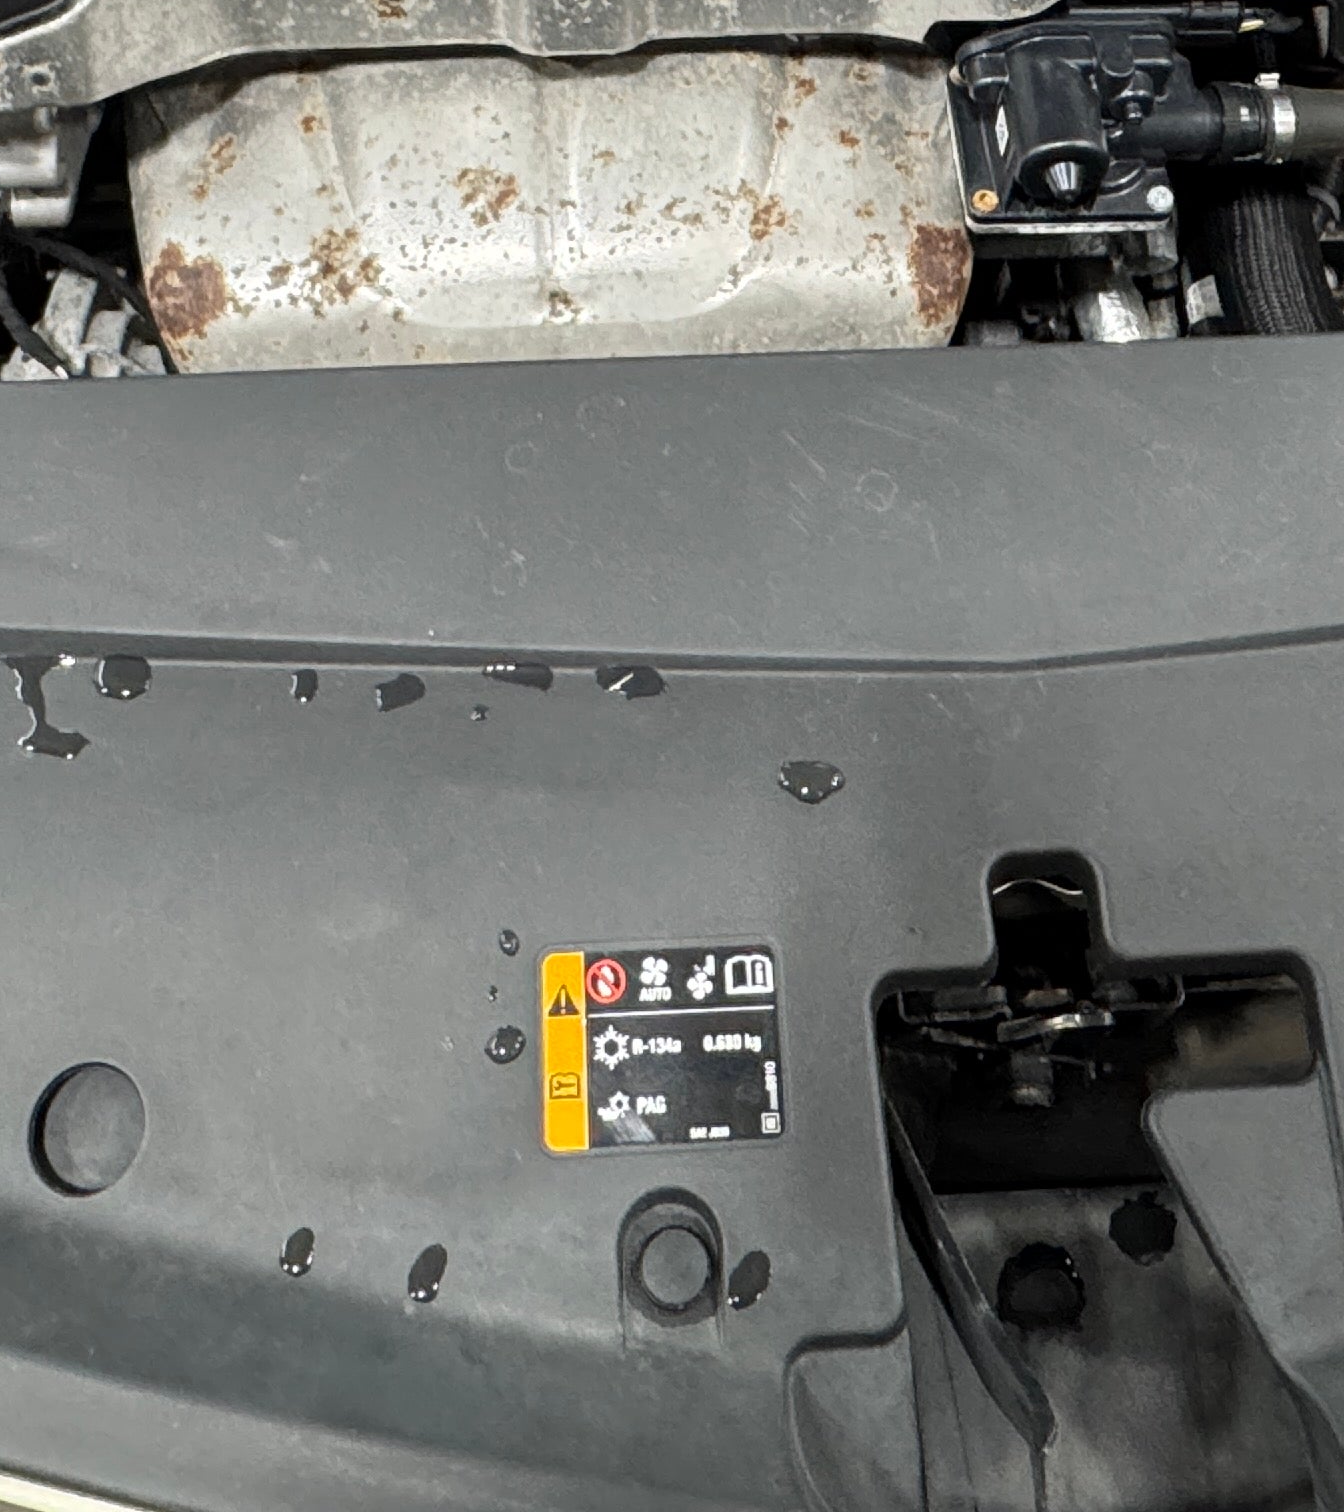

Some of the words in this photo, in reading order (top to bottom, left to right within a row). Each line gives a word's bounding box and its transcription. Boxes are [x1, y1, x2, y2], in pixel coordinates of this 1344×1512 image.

[639, 987, 672, 1002] AUTO
[632, 1036, 682, 1055] R-134a
[636, 1094, 668, 1115] PAG
